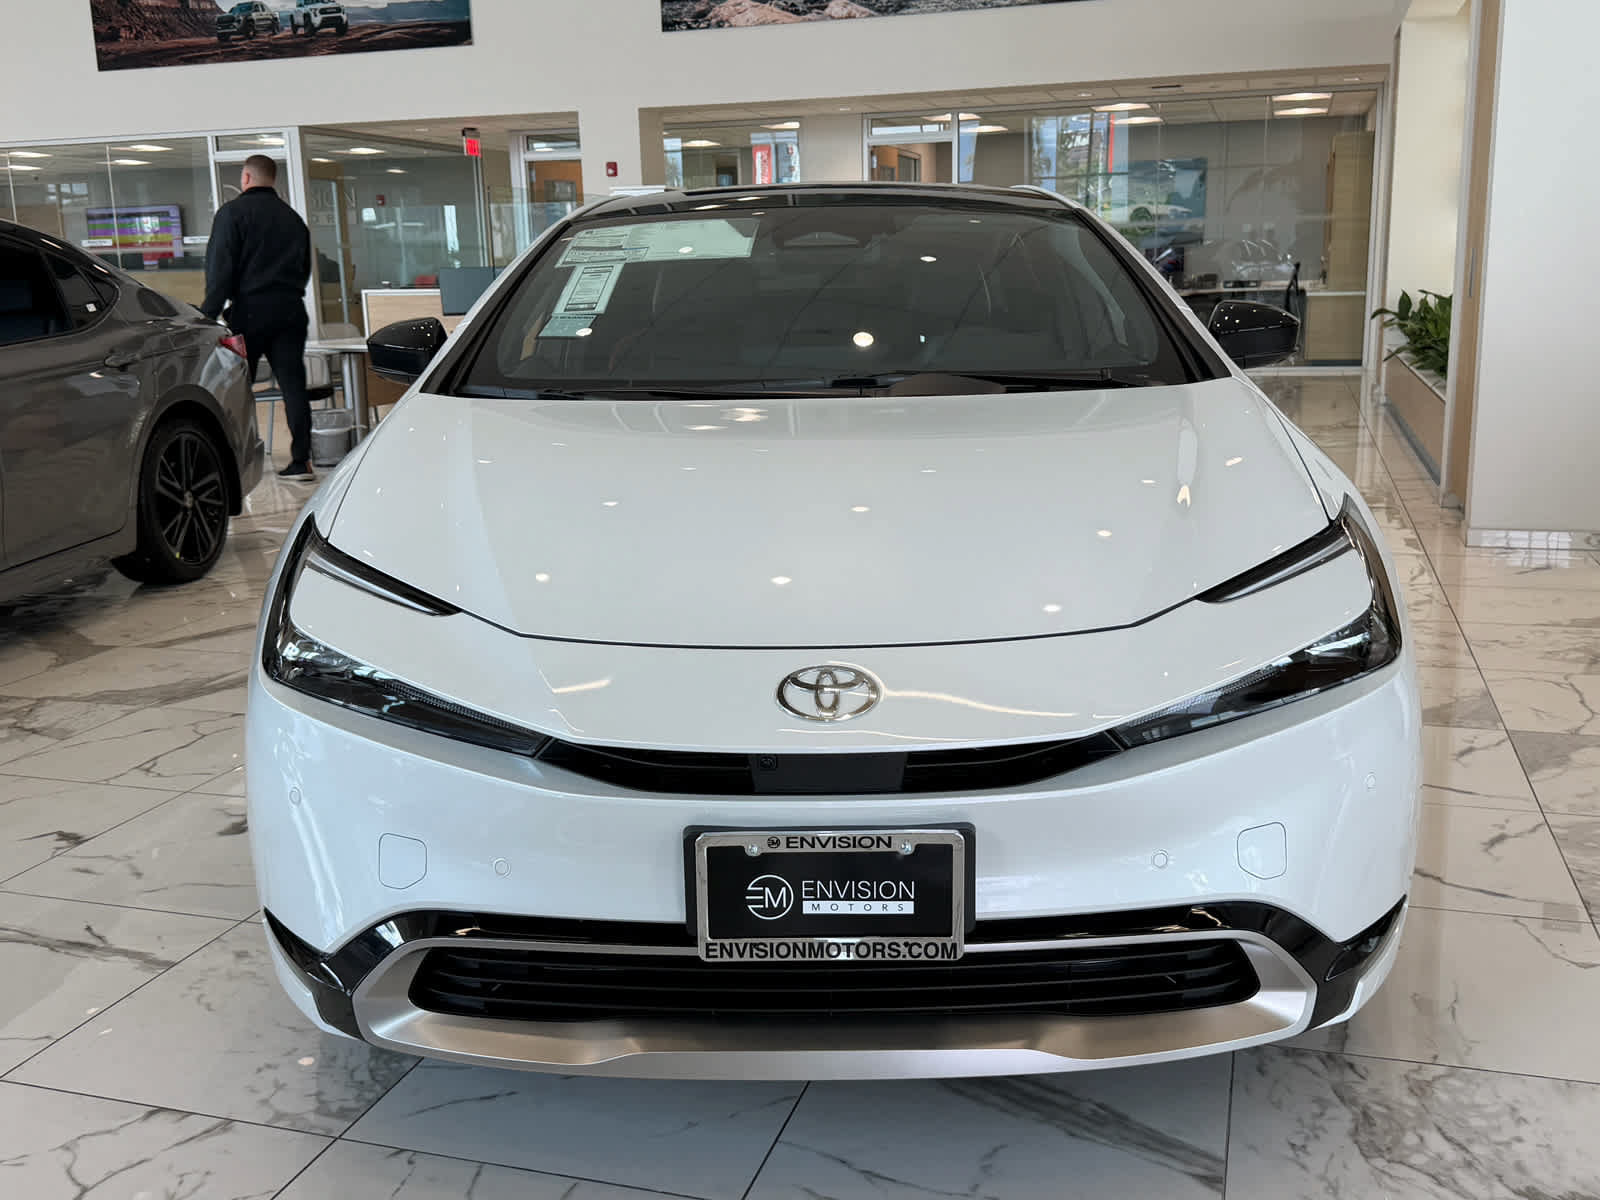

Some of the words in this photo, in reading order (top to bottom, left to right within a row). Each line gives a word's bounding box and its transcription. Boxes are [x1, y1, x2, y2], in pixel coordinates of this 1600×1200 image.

[785, 836, 892, 849] ENVISION
[802, 880, 915, 900] ENVISION
[811, 903, 904, 912] MOTORS
[705, 942, 958, 960] ENVISIONMOTORS.COM
